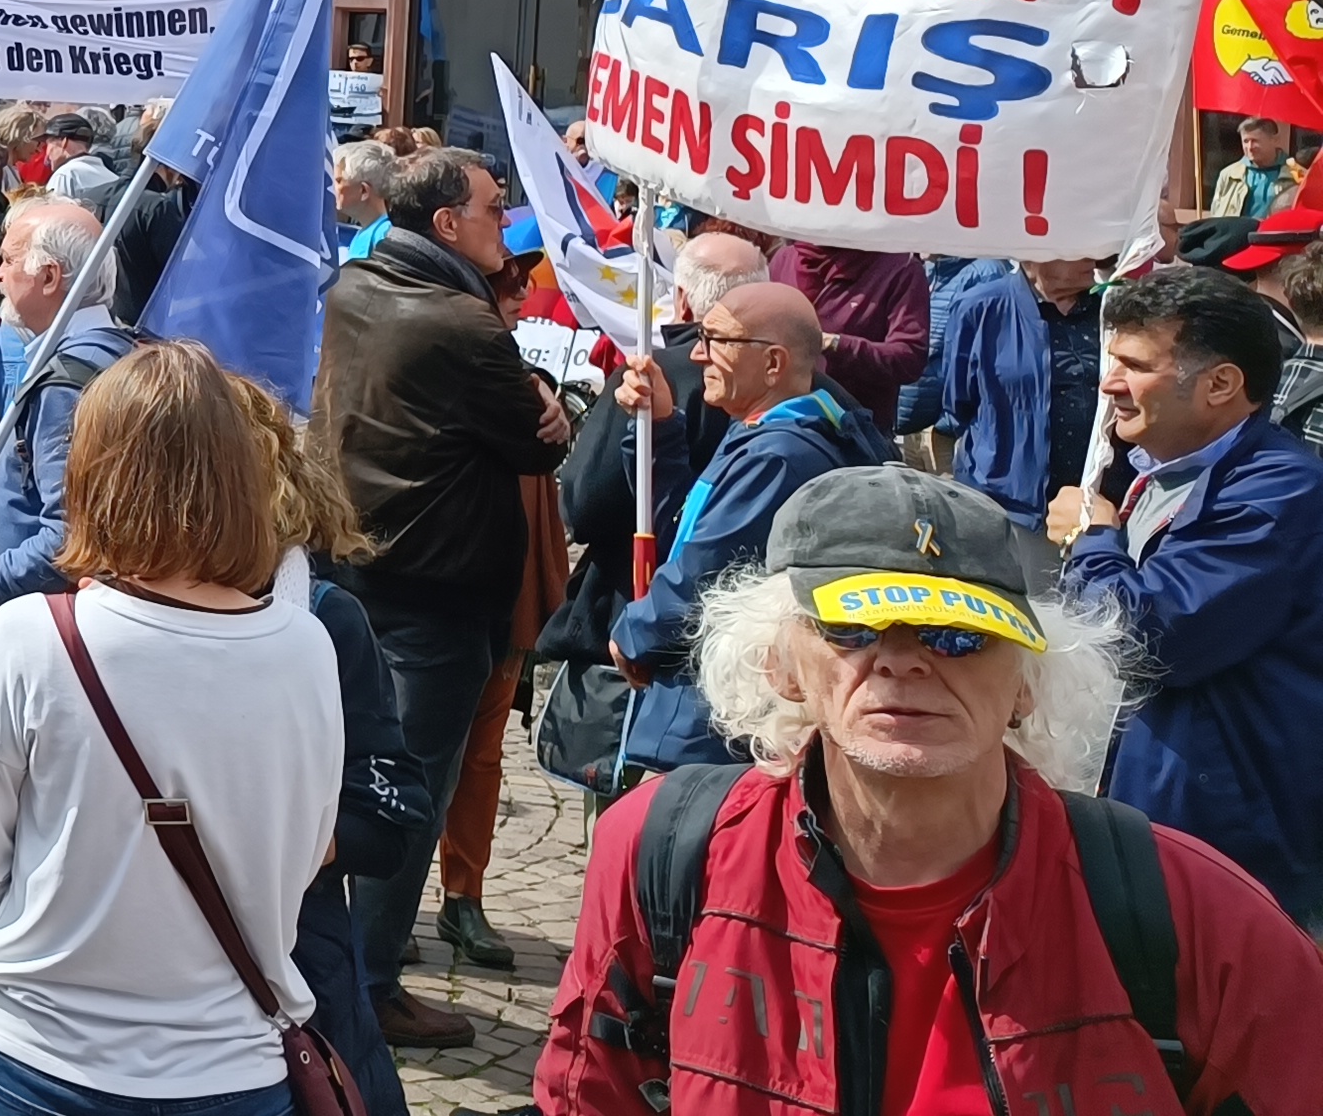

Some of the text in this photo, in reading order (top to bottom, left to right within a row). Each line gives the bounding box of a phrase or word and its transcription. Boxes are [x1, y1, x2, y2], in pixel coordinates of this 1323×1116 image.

[7, 40, 63, 73] den
[69, 45, 165, 80] Krieg!
[587, 51, 712, 176] EMEN
[726, 101, 981, 230] ŞİMDİ
[840, 586, 931, 612] STOP
